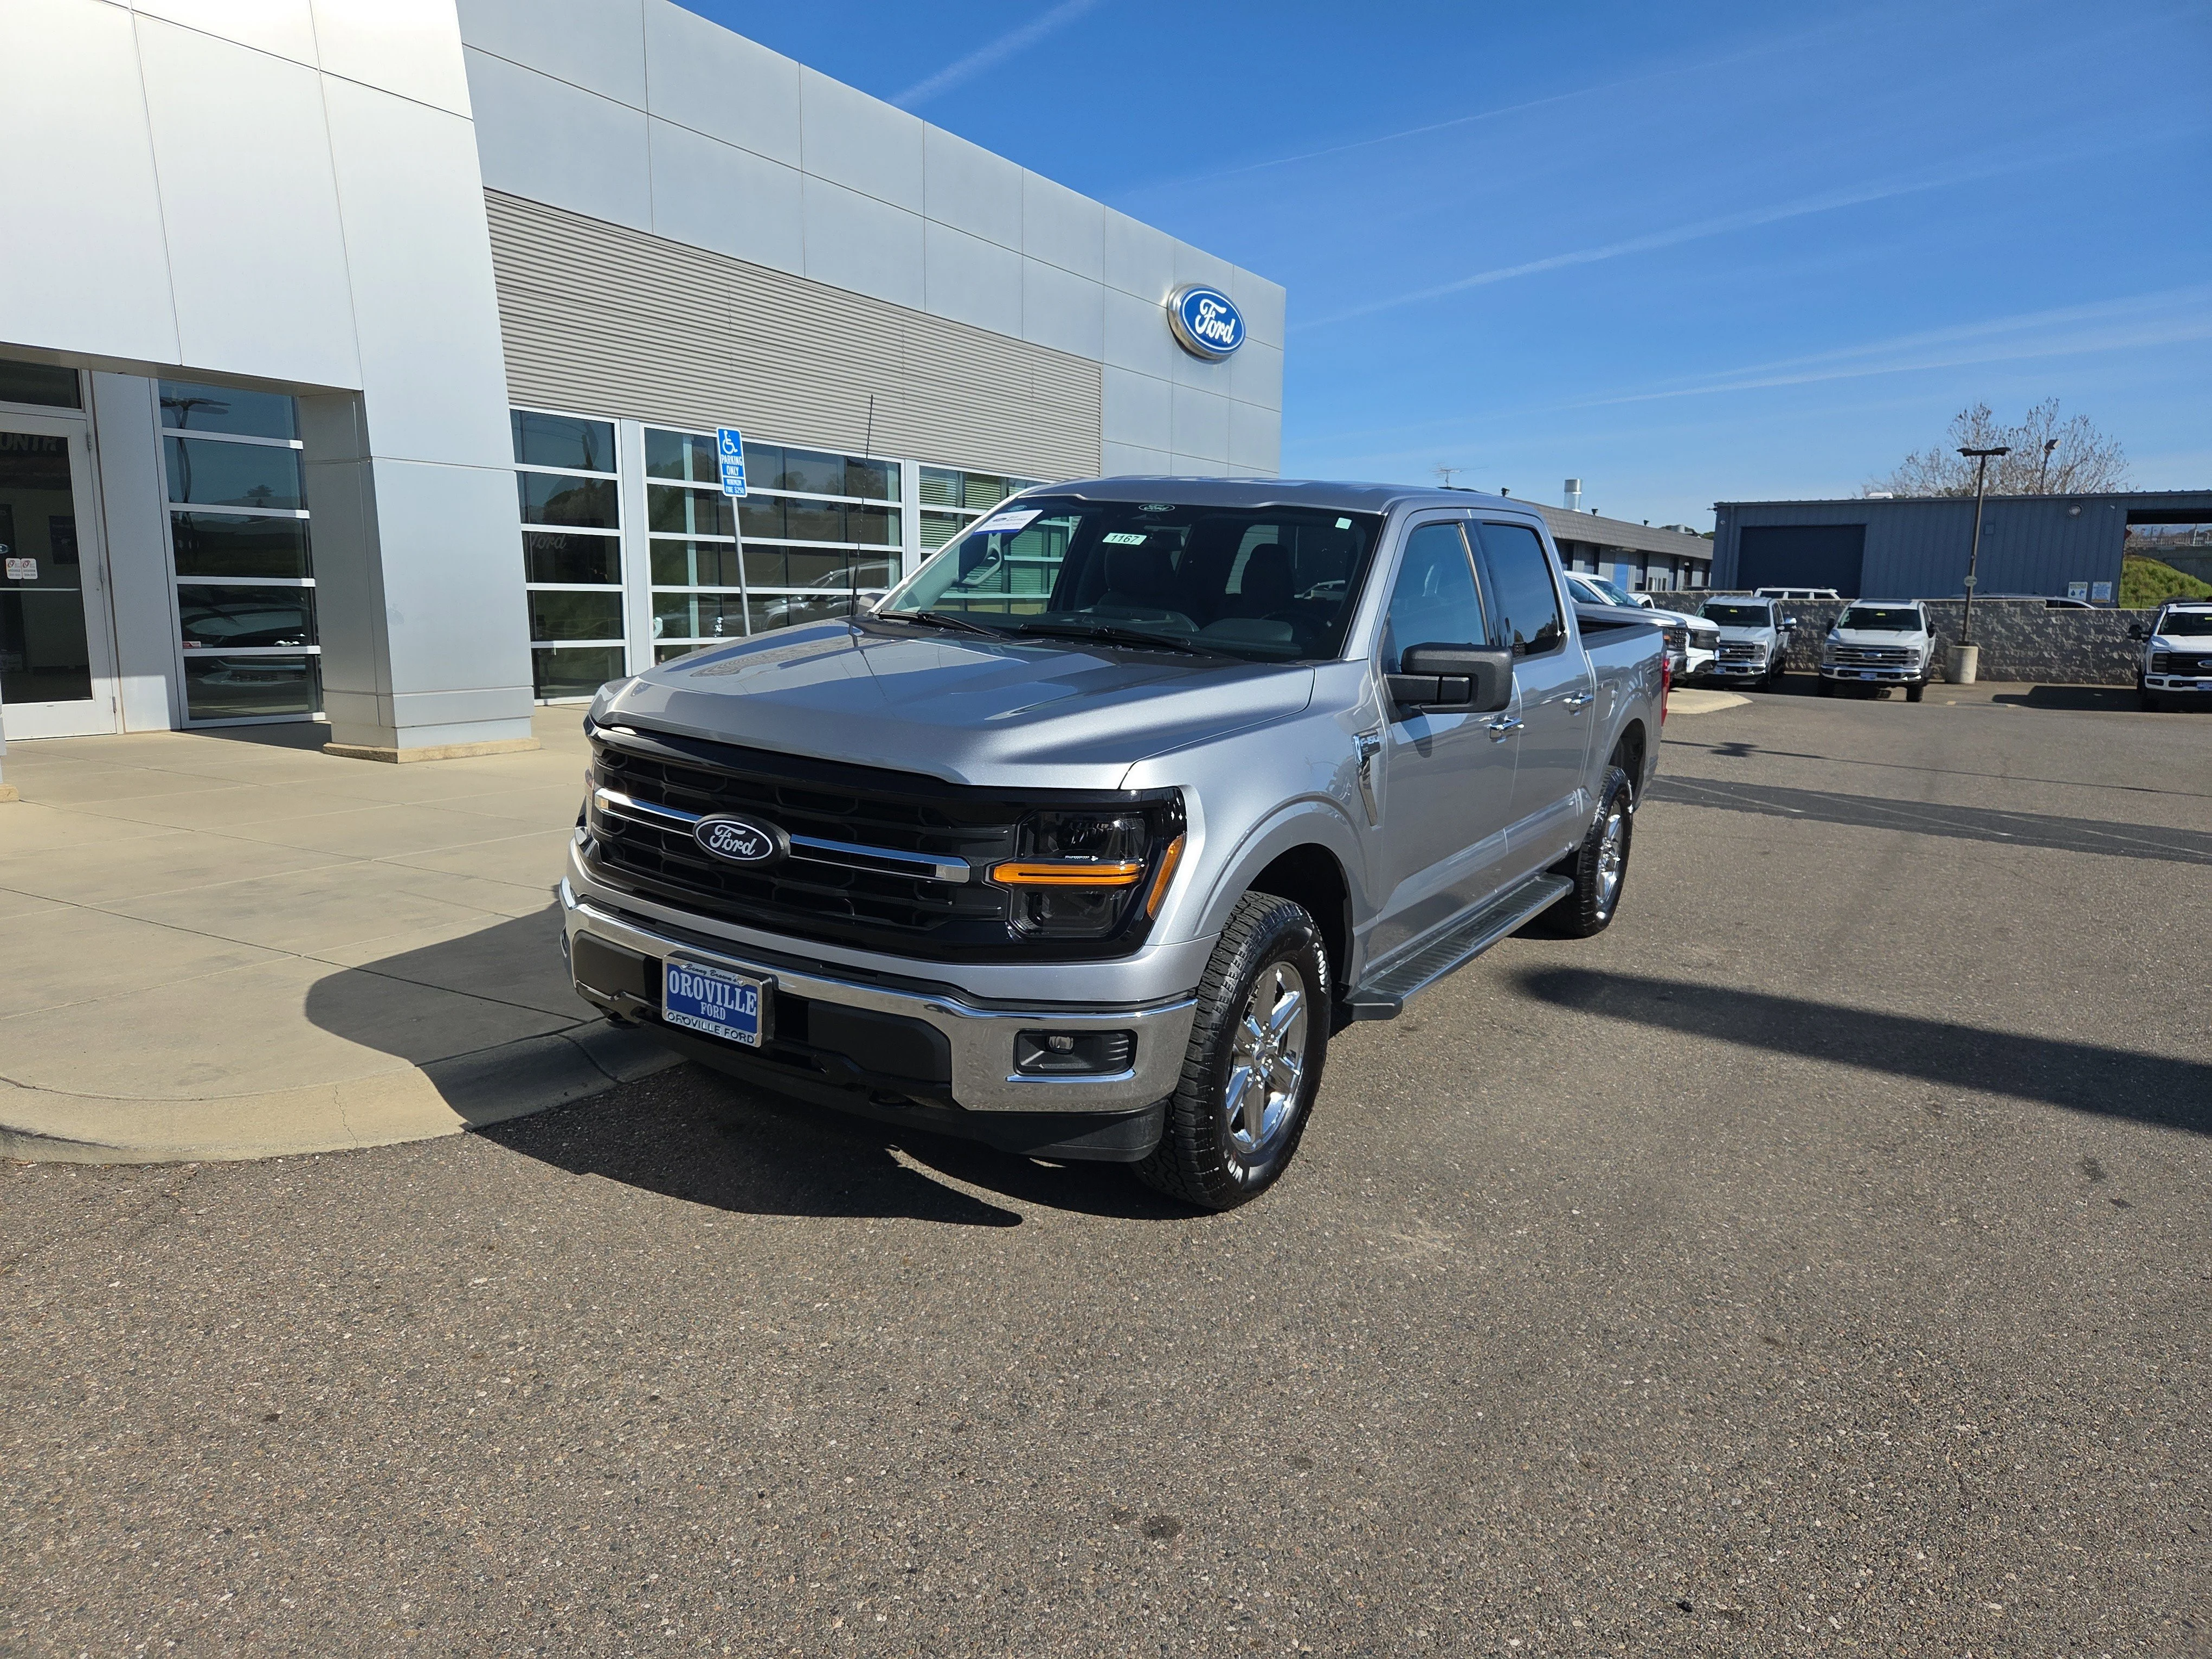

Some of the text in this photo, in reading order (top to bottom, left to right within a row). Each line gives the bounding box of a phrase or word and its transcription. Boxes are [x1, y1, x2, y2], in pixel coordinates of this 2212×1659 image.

[1195, 299, 1236, 344] Ford
[721, 454, 743, 466] PARKING
[726, 465, 739, 476] ONLY
[1111, 535, 1140, 543] 1167
[710, 825, 757, 856] Ford
[669, 970, 757, 1017] OROVILLE
[700, 1001, 726, 1020] FORD
[667, 1012, 755, 1044] OROVILLE FORD
